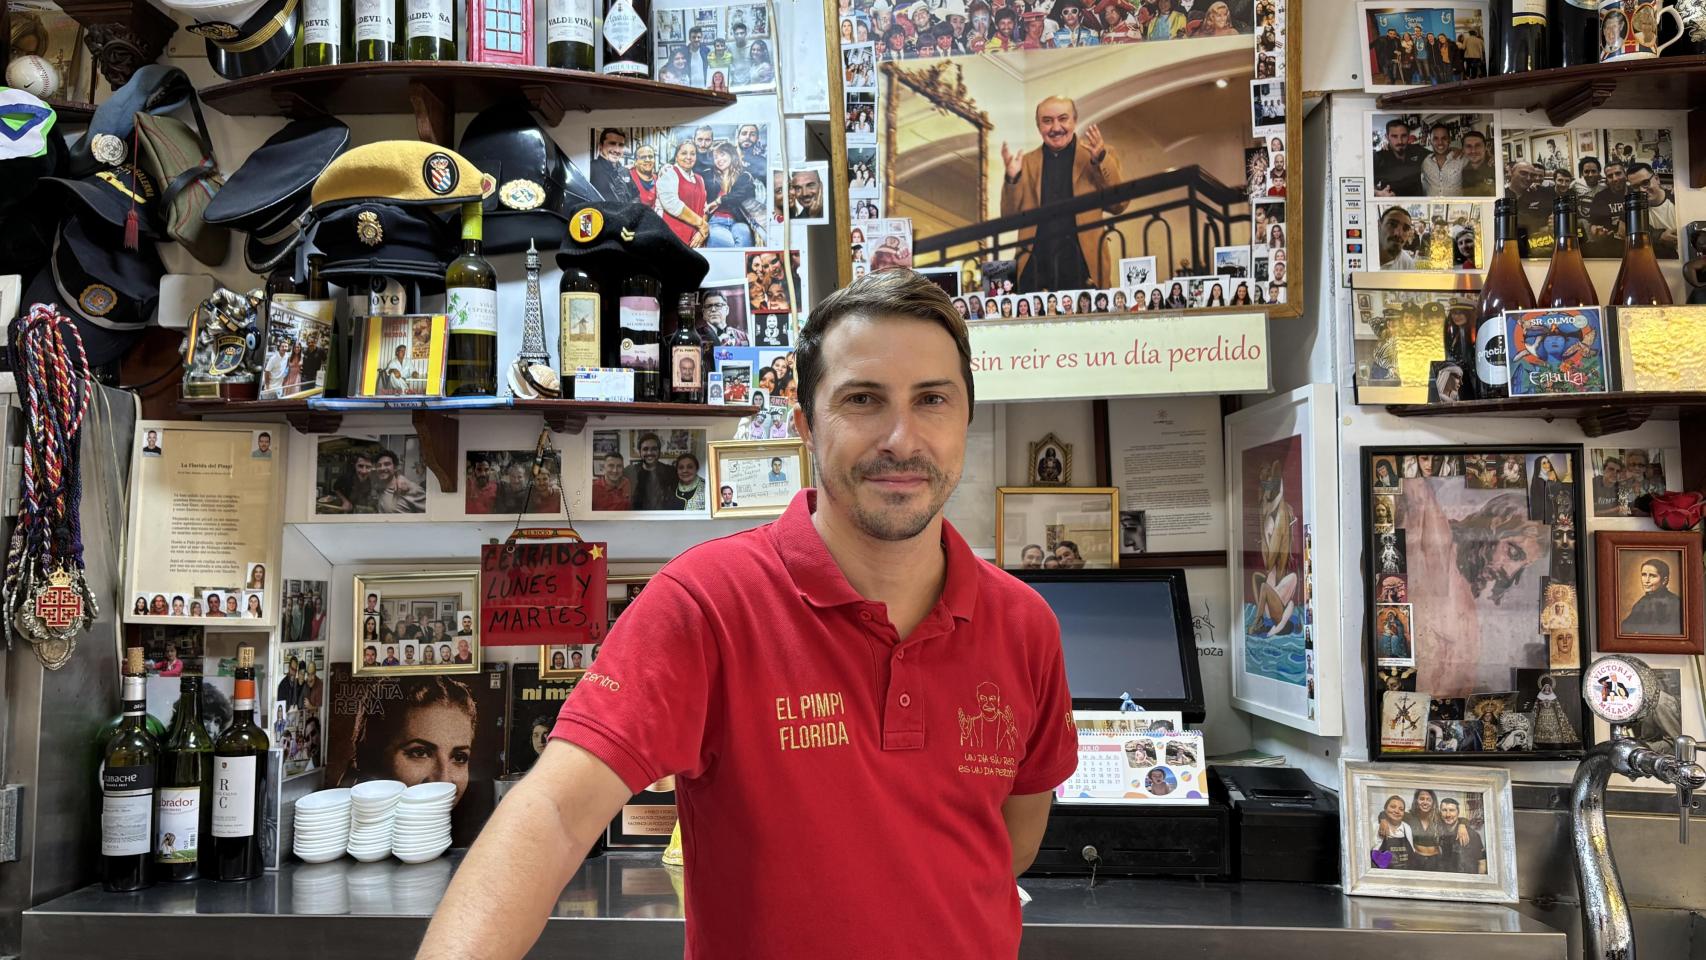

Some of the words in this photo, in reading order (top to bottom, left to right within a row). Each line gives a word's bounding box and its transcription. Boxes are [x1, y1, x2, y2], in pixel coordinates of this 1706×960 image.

[548, 16, 592, 29] VALDEVIÑA
[1548, 317, 1575, 325] OLMO
[970, 350, 1003, 372] sin
[1010, 348, 1050, 370] reir
[1056, 352, 1078, 369] es
[1085, 350, 1117, 367] un
[1124, 338, 1161, 366] día
[1168, 334, 1261, 372] perdido
[484, 543, 589, 573] CERRADO
[487, 574, 557, 599] LUNES
[575, 573, 592, 599] Y
[488, 605, 587, 633] MARTES
[1593, 664, 1633, 681] VICTORIA
[335, 683, 403, 700] JUANITA
[522, 685, 542, 700] ni
[334, 700, 385, 715] REINA
[776, 696, 797, 720] EL
[800, 691, 845, 719] PIMPI
[779, 721, 850, 751] FLORIDA
[219, 779, 230, 791] R
[219, 797, 228, 809] C
